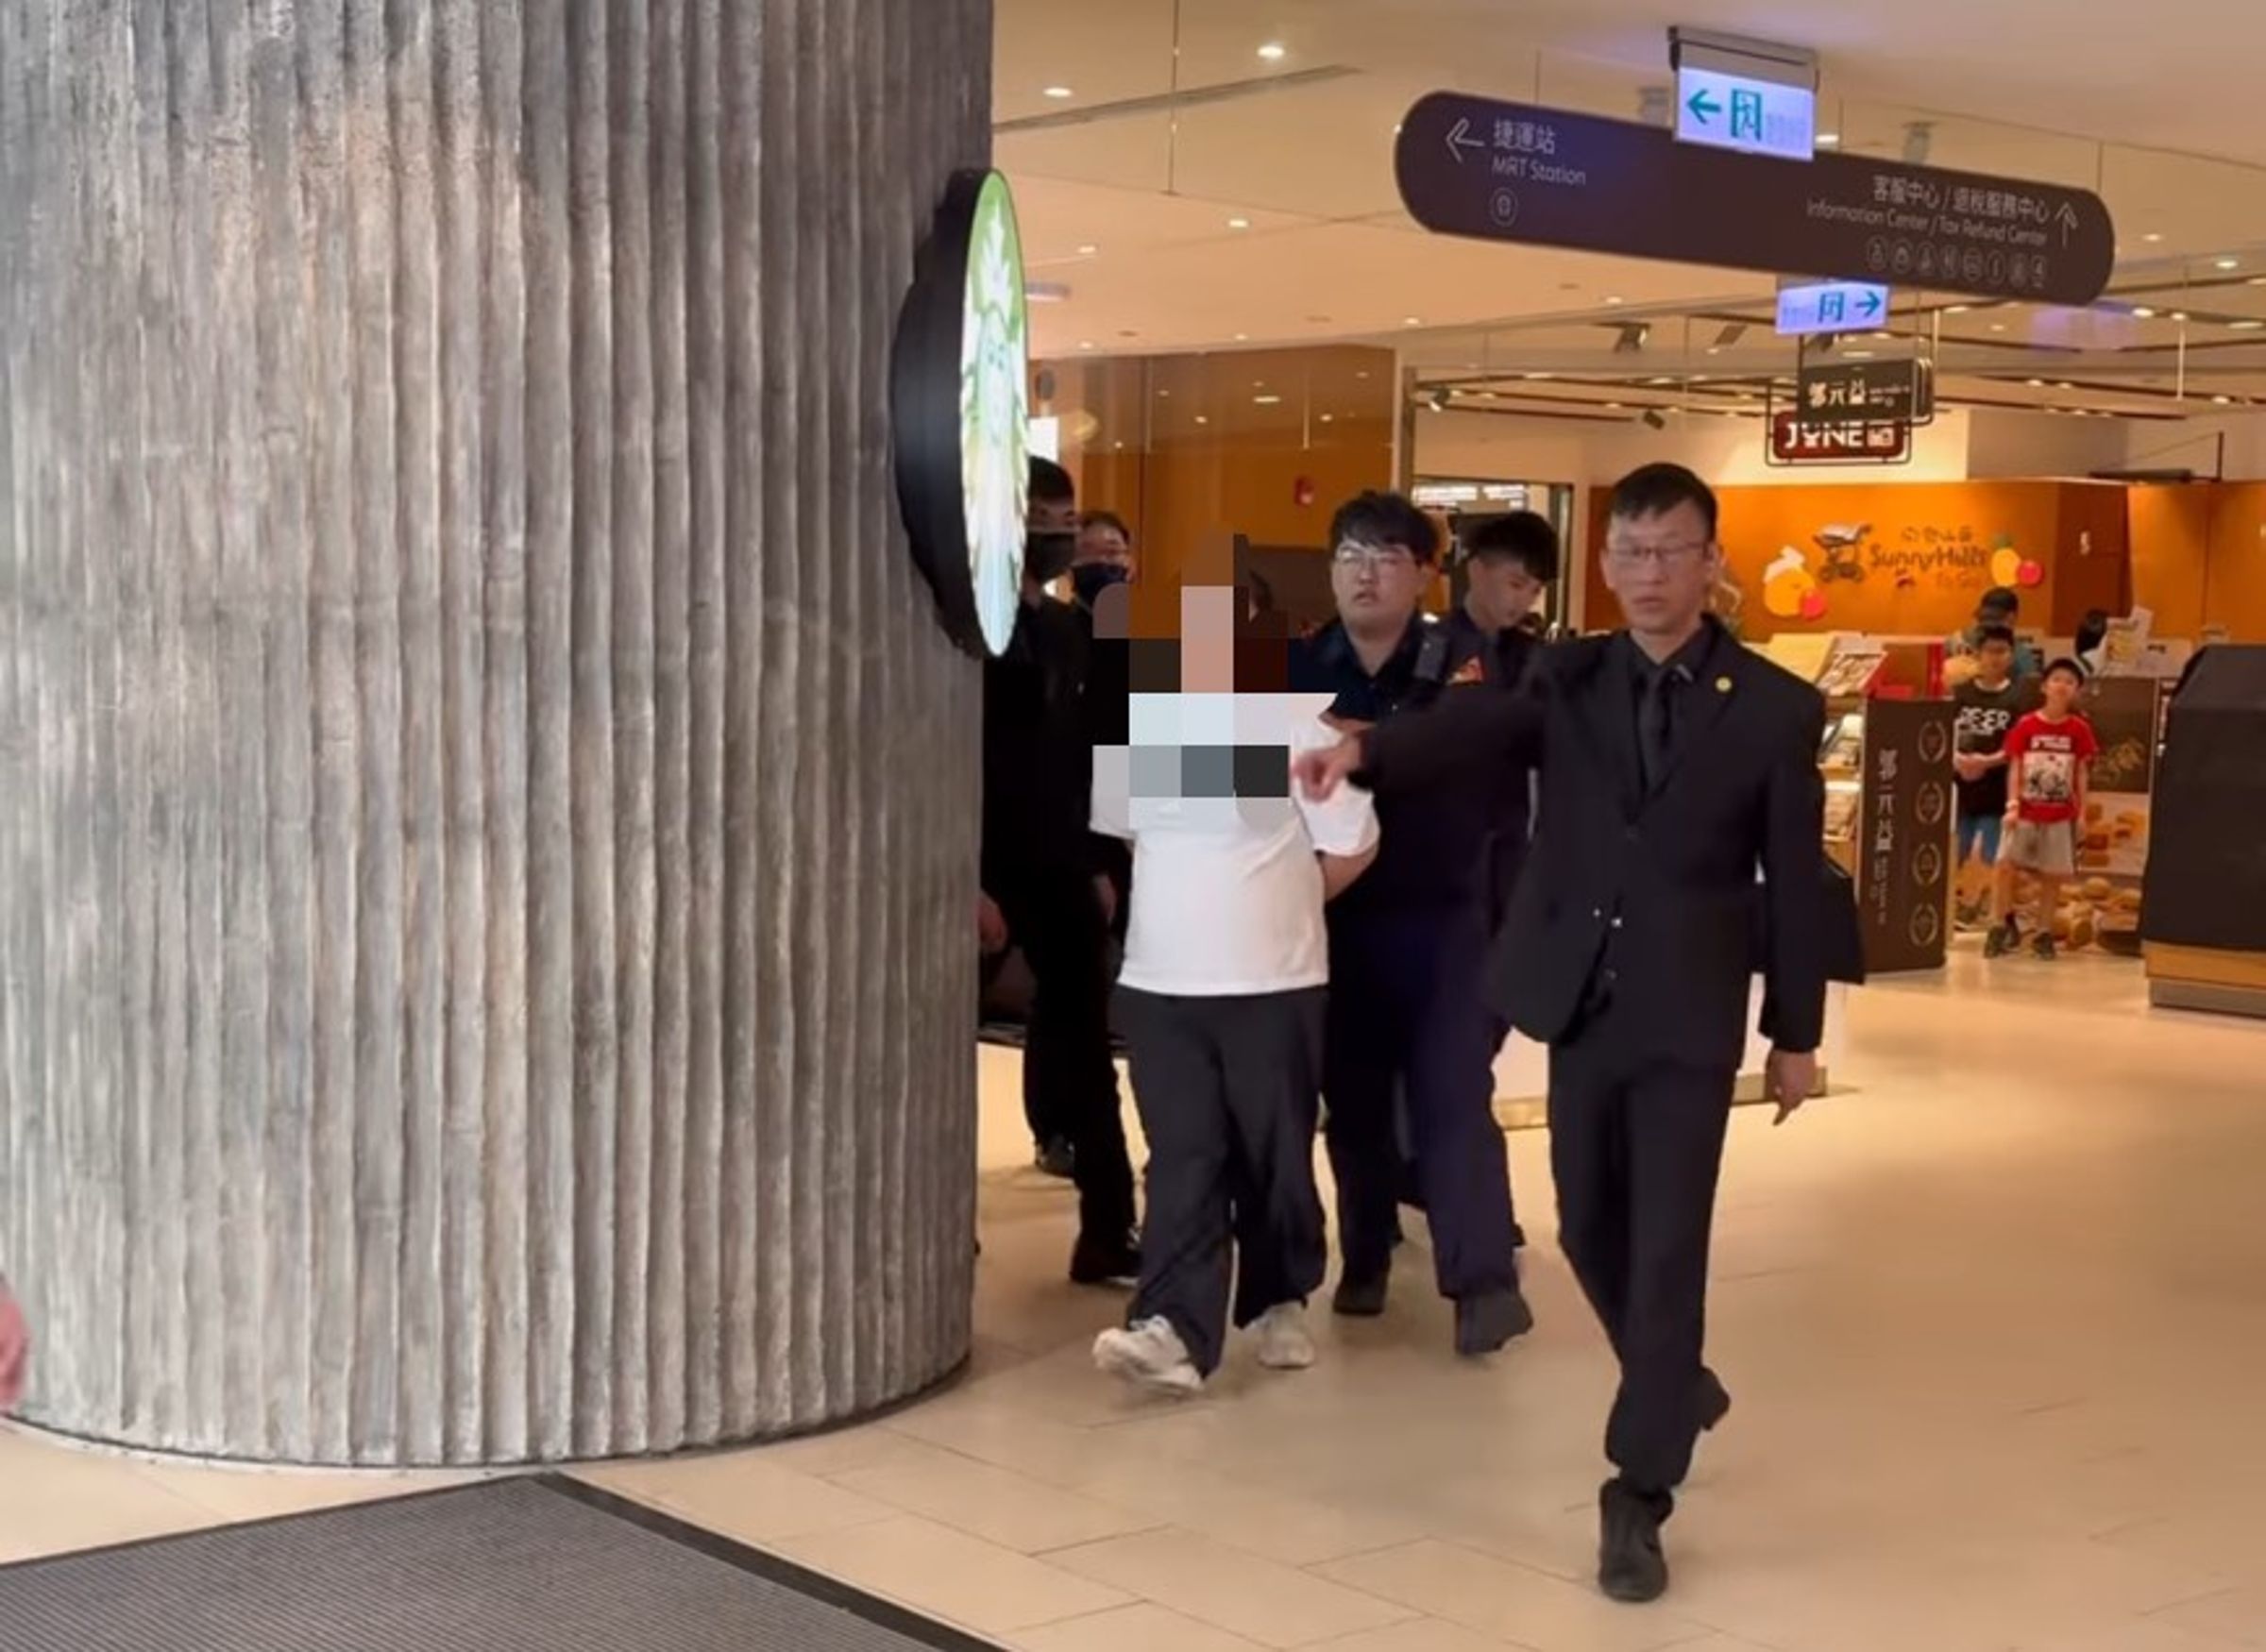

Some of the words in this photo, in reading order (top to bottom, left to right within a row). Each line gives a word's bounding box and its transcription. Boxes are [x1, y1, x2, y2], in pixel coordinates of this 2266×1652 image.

[1493, 117, 1556, 155] 捷運站
[1492, 156, 1528, 177] MRT
[1530, 159, 1587, 186] Station
[1872, 175, 1939, 209] 客服中心
[1806, 198, 1885, 225] Information
[1887, 209, 1929, 231] Center
[1938, 215, 1959, 235] Tax
[1962, 218, 2006, 243] Refund
[2007, 225, 2048, 247] Center
